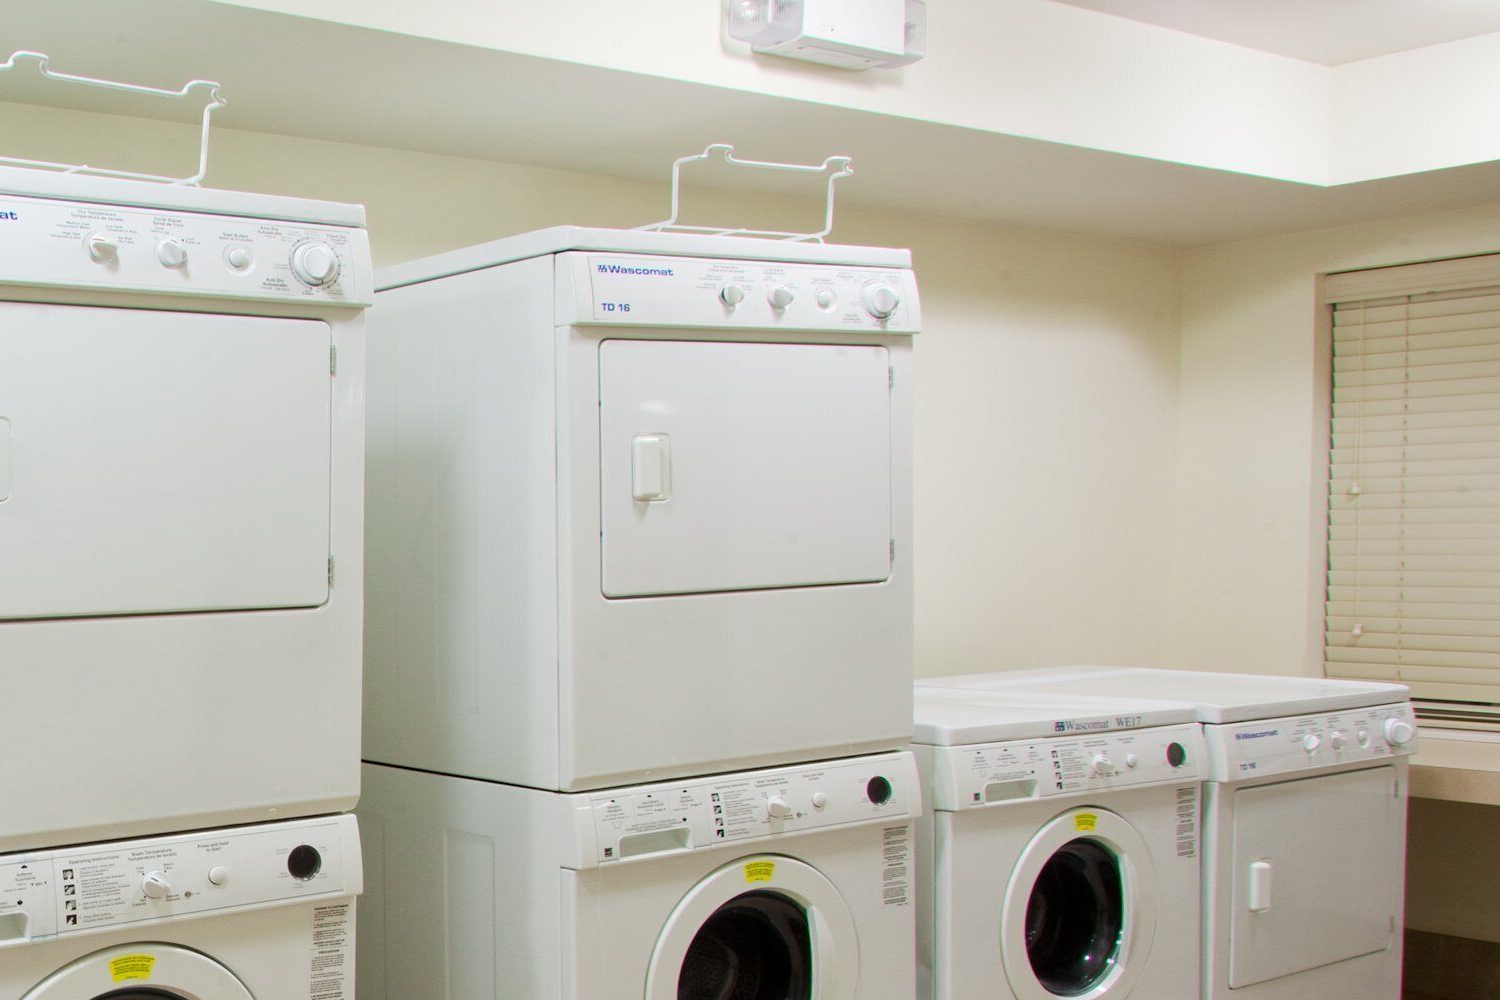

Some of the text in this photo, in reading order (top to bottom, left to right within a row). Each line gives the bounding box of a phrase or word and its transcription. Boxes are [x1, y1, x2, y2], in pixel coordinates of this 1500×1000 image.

[608, 265, 674, 277] Wascomat
[601, 302, 630, 312] TD 16
[1065, 719, 1109, 731] Wascomat
